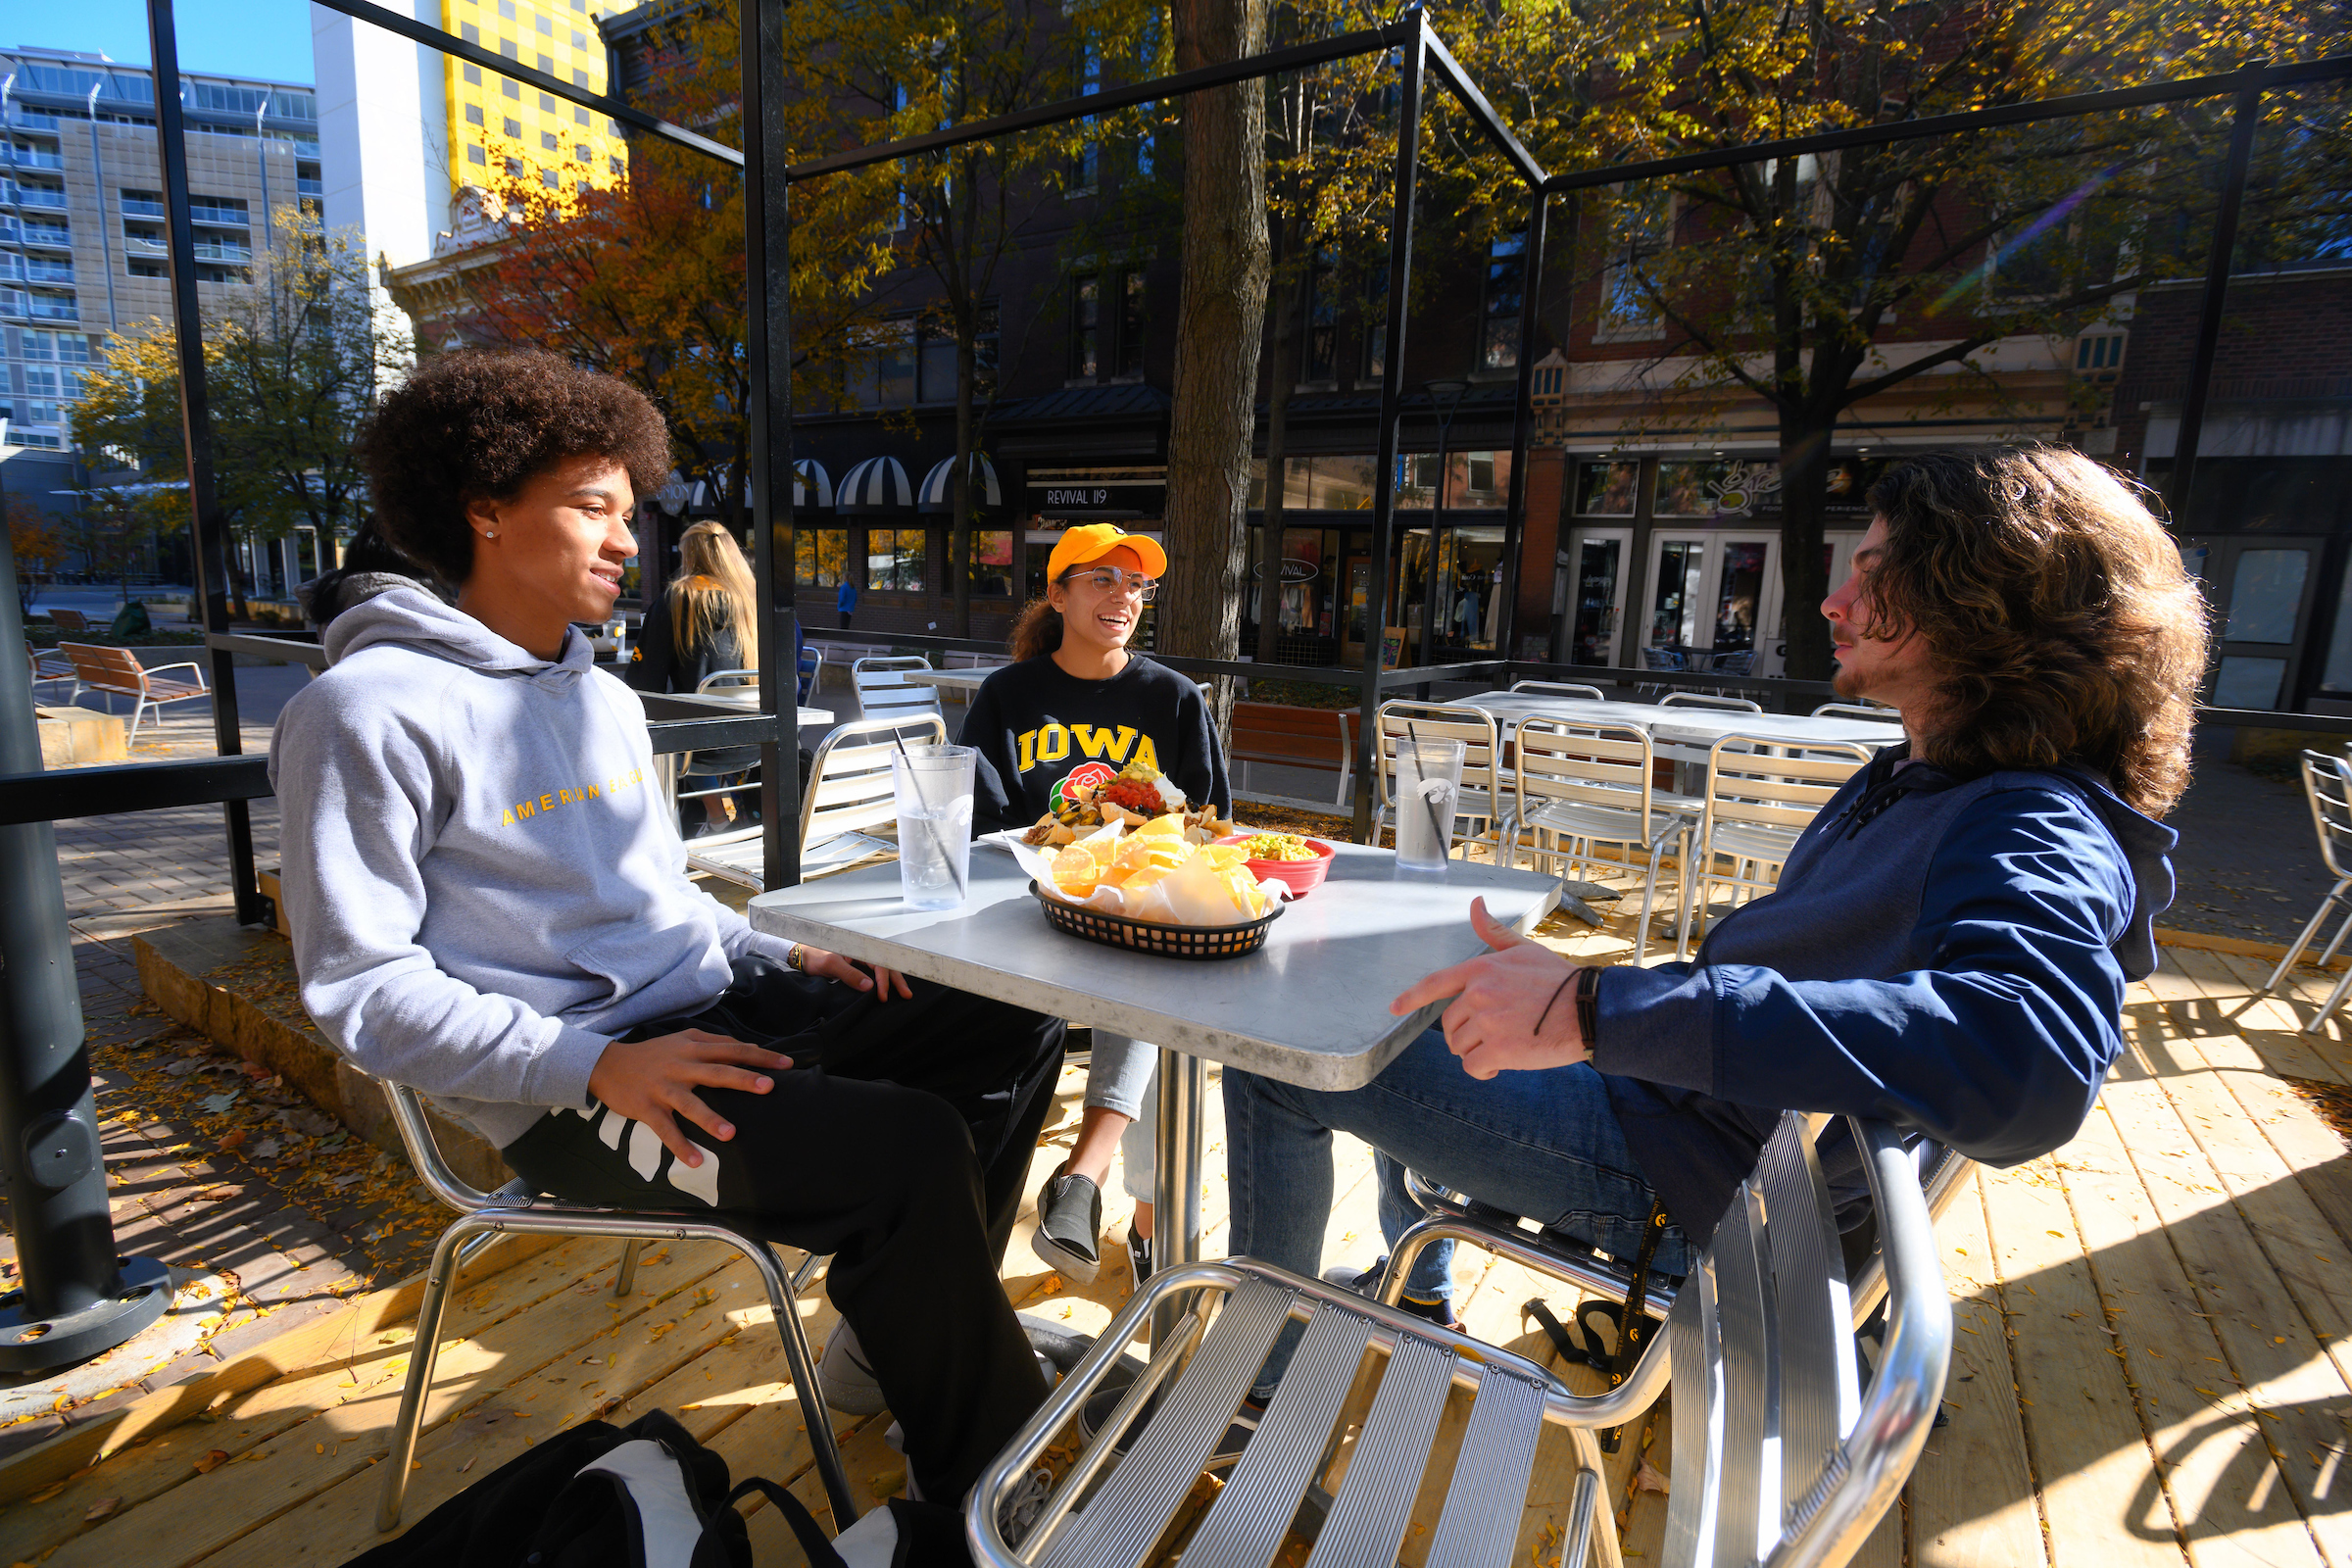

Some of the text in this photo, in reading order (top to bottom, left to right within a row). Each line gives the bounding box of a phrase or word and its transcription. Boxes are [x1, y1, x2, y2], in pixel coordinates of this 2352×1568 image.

[1047, 488, 1107, 505] REVIVAL 119
[1017, 723, 1160, 773] IOWA
